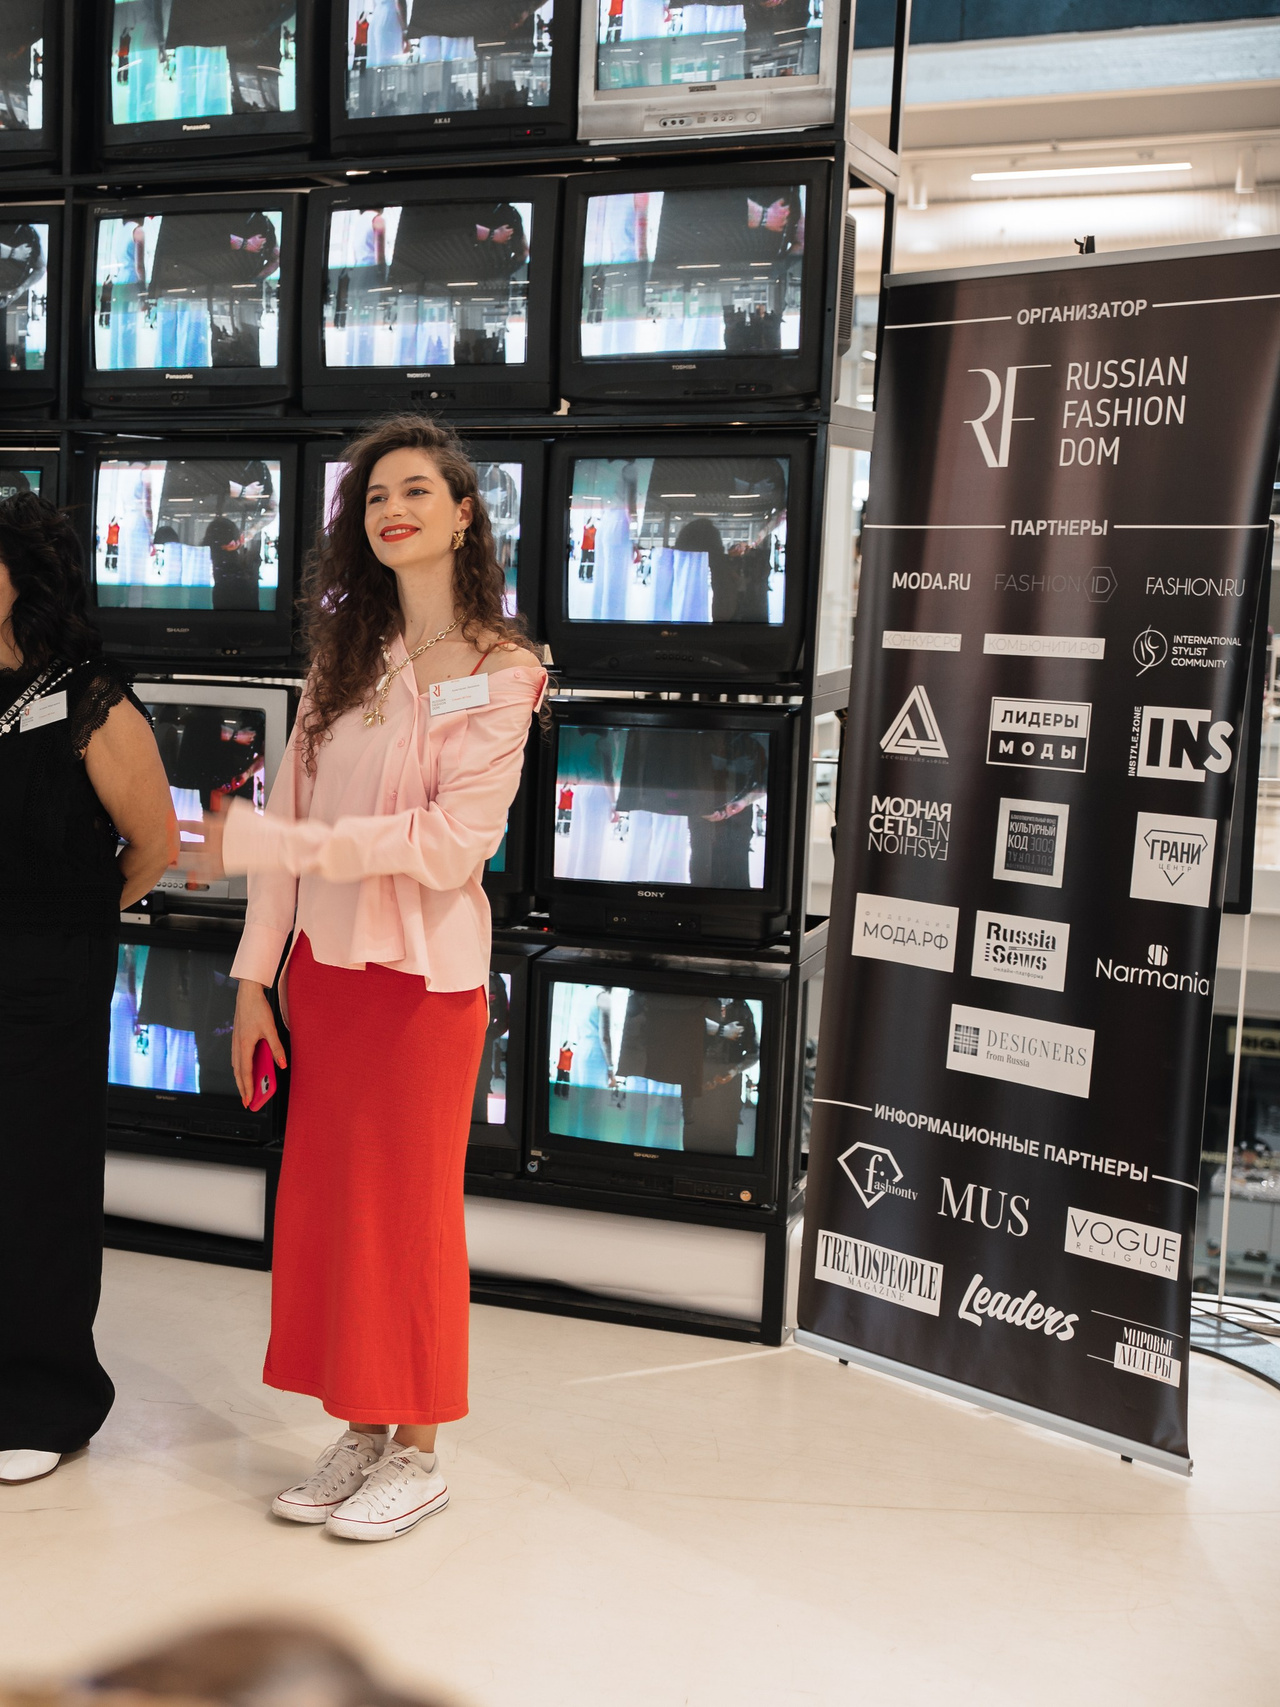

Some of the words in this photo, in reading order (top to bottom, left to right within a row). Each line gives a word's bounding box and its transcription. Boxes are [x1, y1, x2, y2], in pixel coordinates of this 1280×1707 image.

[1016, 299, 1148, 326] ОРГАНИЗАТОР
[1065, 355, 1189, 391] RUSSIAN
[1062, 395, 1186, 429] FASHION
[1058, 436, 1121, 467] DOM
[1009, 520, 1109, 537] ПАРТНЕРЫ
[892, 571, 971, 591] MODA.RU
[994, 573, 1081, 593] FASHION
[1091, 576, 1111, 594] ID
[1145, 576, 1246, 598] FASHION.RU
[1172, 647, 1208, 656] STYLIST
[1173, 635, 1242, 646] INTERNATIONAL
[1171, 658, 1228, 669] COMMUNITY
[1001, 709, 1080, 729] ЛИДЕРЫ
[998, 739, 1077, 761] МОДЫ
[1127, 706, 1142, 777] INSTYLE.ZONE
[869, 814, 918, 837] СЕТЬ
[1009, 821, 1056, 837] КУЛЬТУРНЫЙ
[1007, 834, 1029, 852] КОД
[1149, 838, 1202, 866] ГРАНИ
[1157, 862, 1193, 873] ЦЕНТР
[637, 890, 665, 898] SONY
[865, 910, 951, 929] ФЕДЕРАЦИЯ
[863, 921, 949, 950] МОДА.РФ
[986, 921, 1057, 950] Russia
[992, 944, 1047, 971] Sews
[1095, 956, 1211, 997] Narmania
[985, 1050, 1005, 1063] from
[1006, 1053, 1030, 1068] Russia
[986, 1029, 1088, 1067] DESIGNERS
[874, 1102, 1040, 1158] ИНФОРМАЦИОННЫЕ
[1043, 1145, 1149, 1183] ПАРТНЕРЫ
[937, 1176, 1031, 1237] MUS
[1070, 1213, 1178, 1263] VOGUE
[821, 1234, 940, 1301] TRENDSPEOPLE
[1075, 1241, 1173, 1273] RELIGION
[847, 1276, 905, 1303] MAGAZINE
[958, 1273, 1080, 1341] Leaders
[1122, 1326, 1175, 1357] МИРОВЫЕ
[1118, 1345, 1172, 1379] ЛИДЕРЫ
